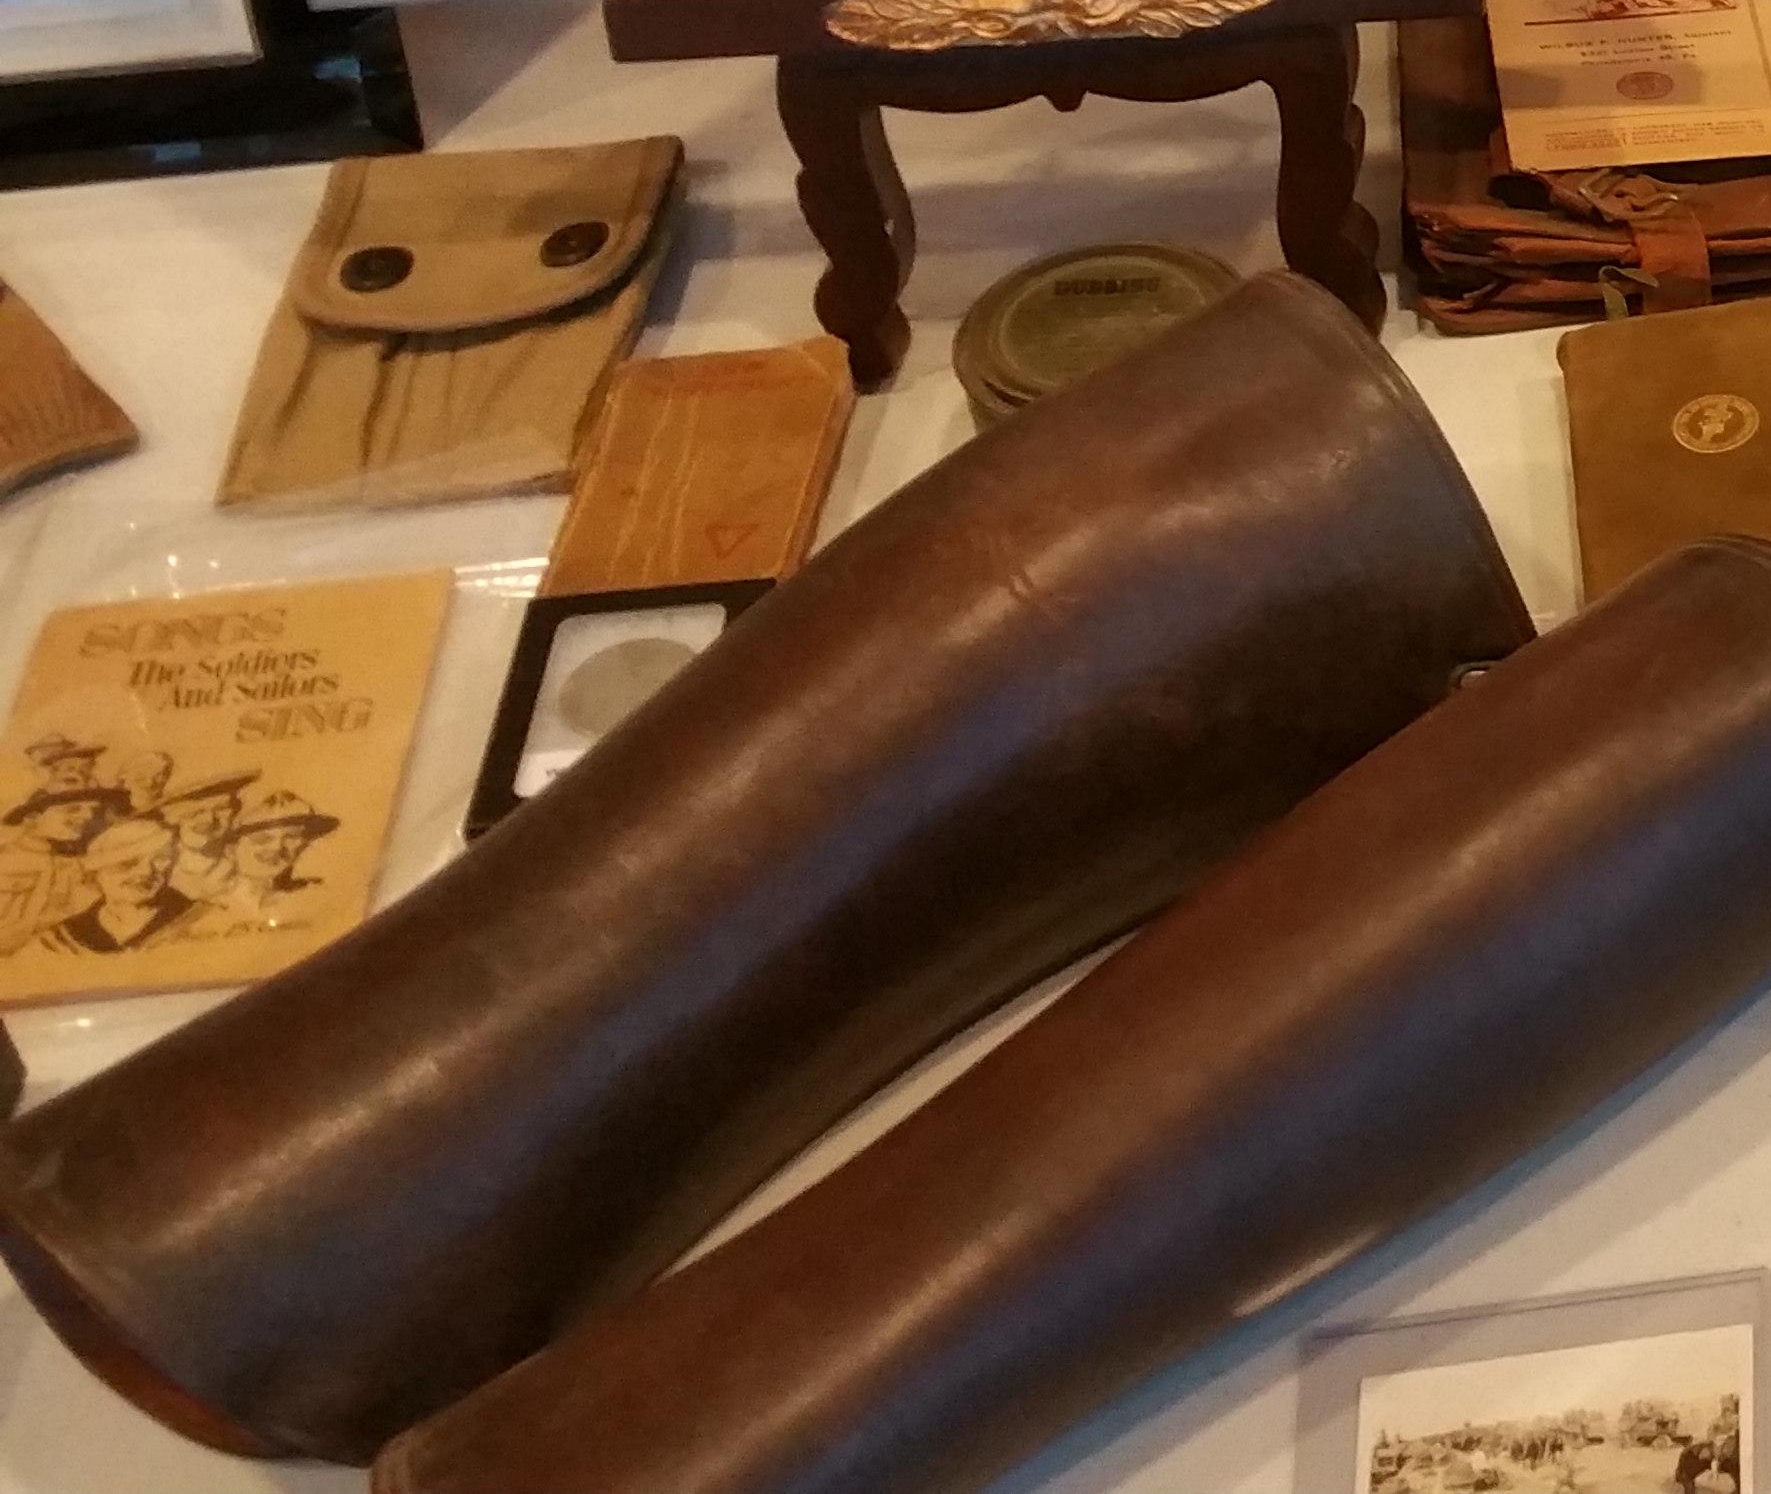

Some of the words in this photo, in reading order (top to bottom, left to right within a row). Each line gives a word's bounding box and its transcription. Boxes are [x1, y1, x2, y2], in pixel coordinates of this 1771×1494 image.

[79, 607, 286, 655] SONGS
[129, 660, 185, 686] The
[198, 648, 322, 678] Soldiers
[157, 677, 224, 711] And
[233, 673, 342, 704] Sailors
[235, 696, 374, 744] SING
